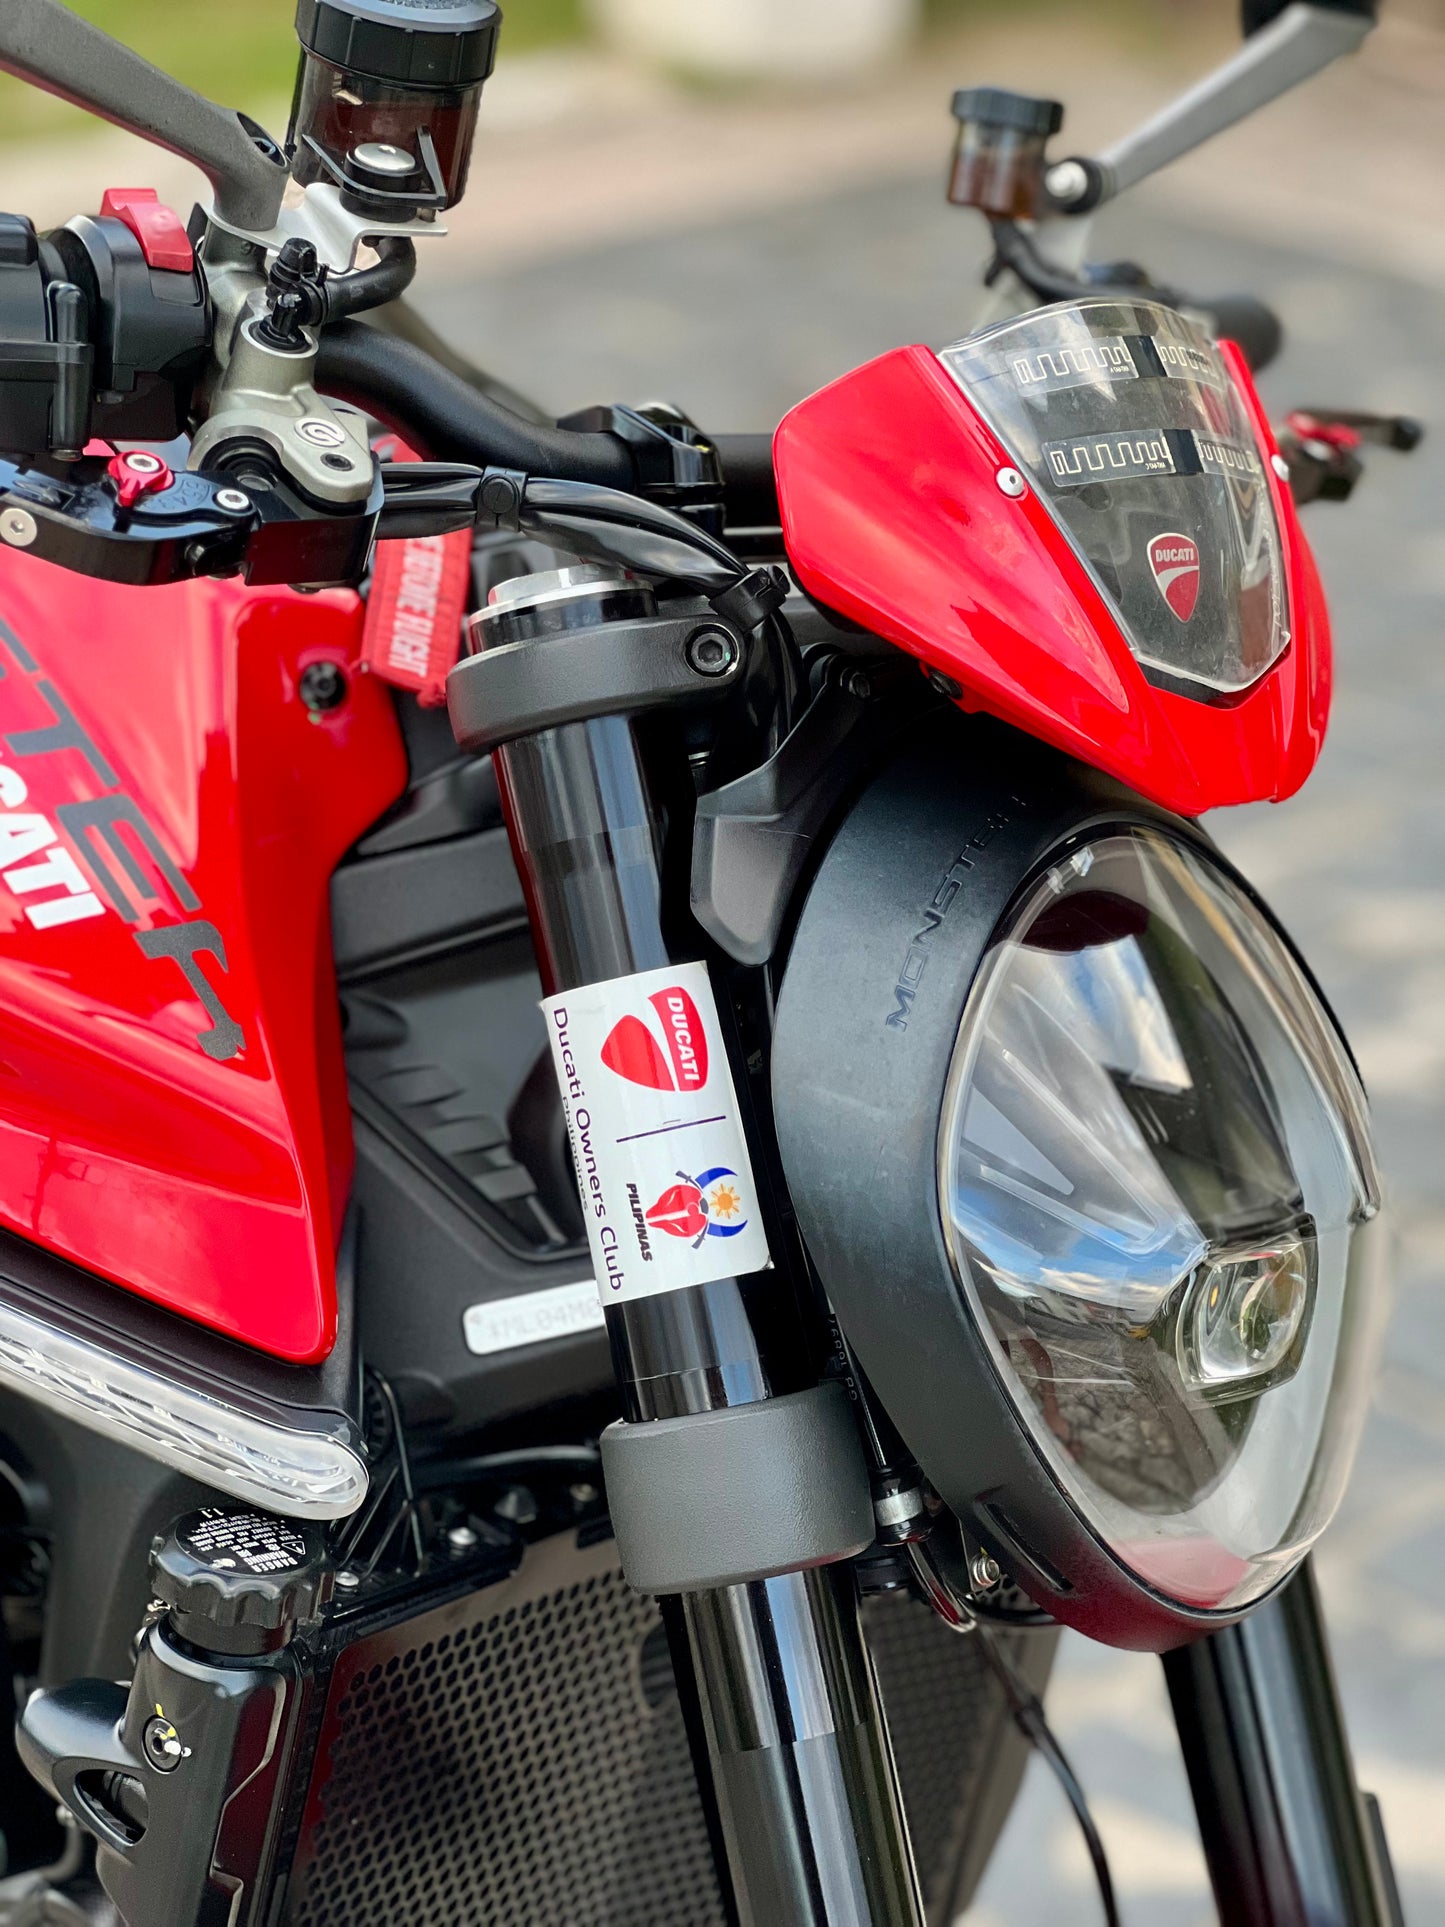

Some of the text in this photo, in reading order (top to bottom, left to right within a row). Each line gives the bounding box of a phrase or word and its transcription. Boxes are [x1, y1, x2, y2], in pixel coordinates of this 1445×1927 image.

[1155, 547, 1195, 562] DUCATI
[886, 796, 1026, 1032] MONSTE
[666, 996, 700, 1081] DUCATI
[553, 1006, 626, 1292] Ducati Owners Club
[626, 1182, 653, 1262] PILIPINAS
[250, 1557, 298, 1572] DANGER
